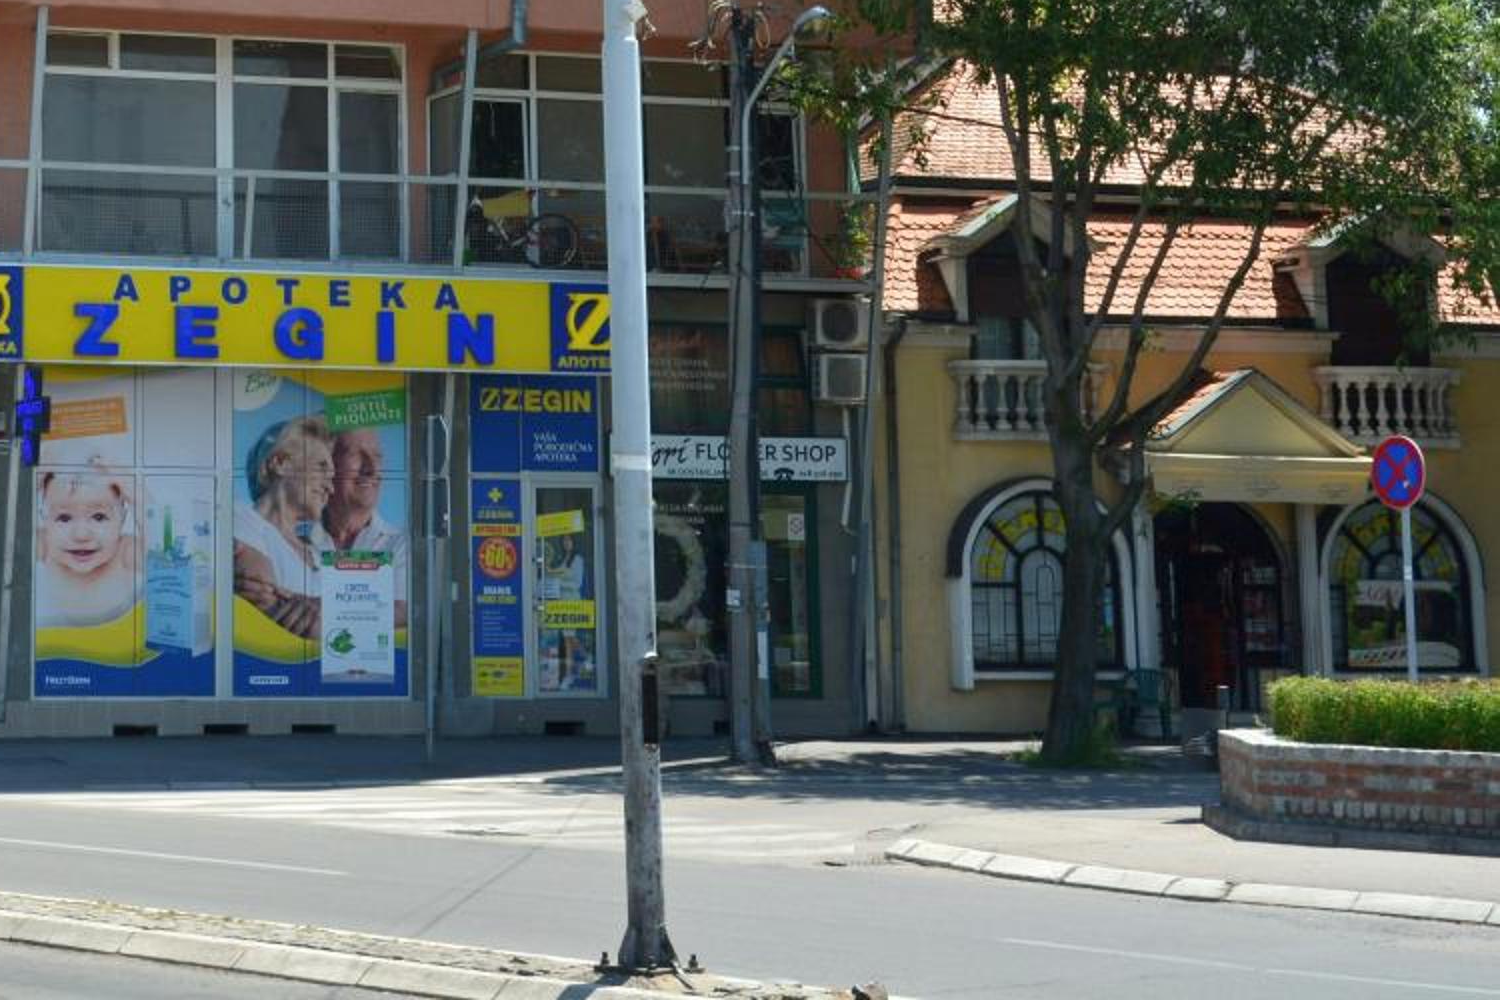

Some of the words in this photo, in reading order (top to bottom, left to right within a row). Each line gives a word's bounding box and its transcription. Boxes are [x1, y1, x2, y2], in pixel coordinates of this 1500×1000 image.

[114, 273, 459, 310] APOTEKA
[73, 303, 495, 364] ZEGIN
[502, 388, 591, 412] ZEGIN
[695, 443, 777, 461] FLOER
[782, 445, 837, 463] SHOP
